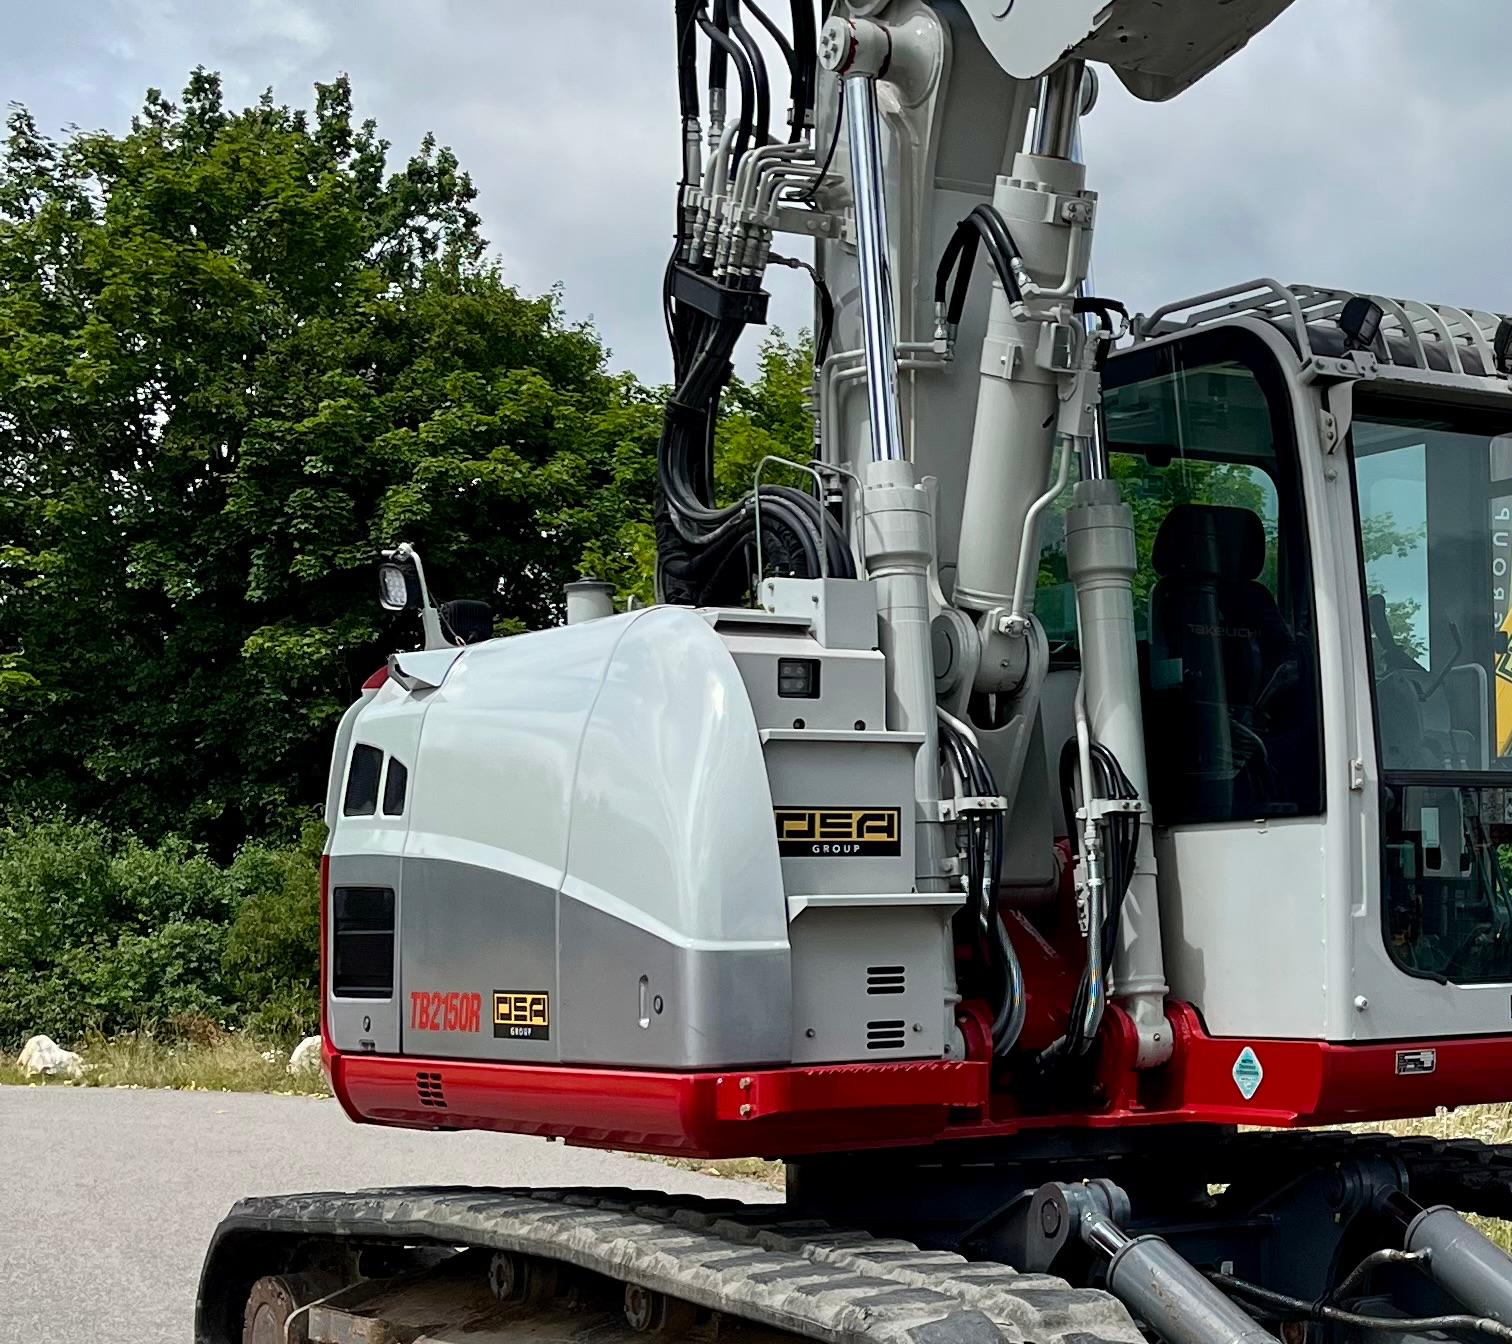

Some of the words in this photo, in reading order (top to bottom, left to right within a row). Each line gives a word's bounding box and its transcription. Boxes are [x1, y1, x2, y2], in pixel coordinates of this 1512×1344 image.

[811, 844, 861, 854] GROUP
[409, 991, 483, 1033] TB2150R
[509, 1026, 532, 1037] GROUP
